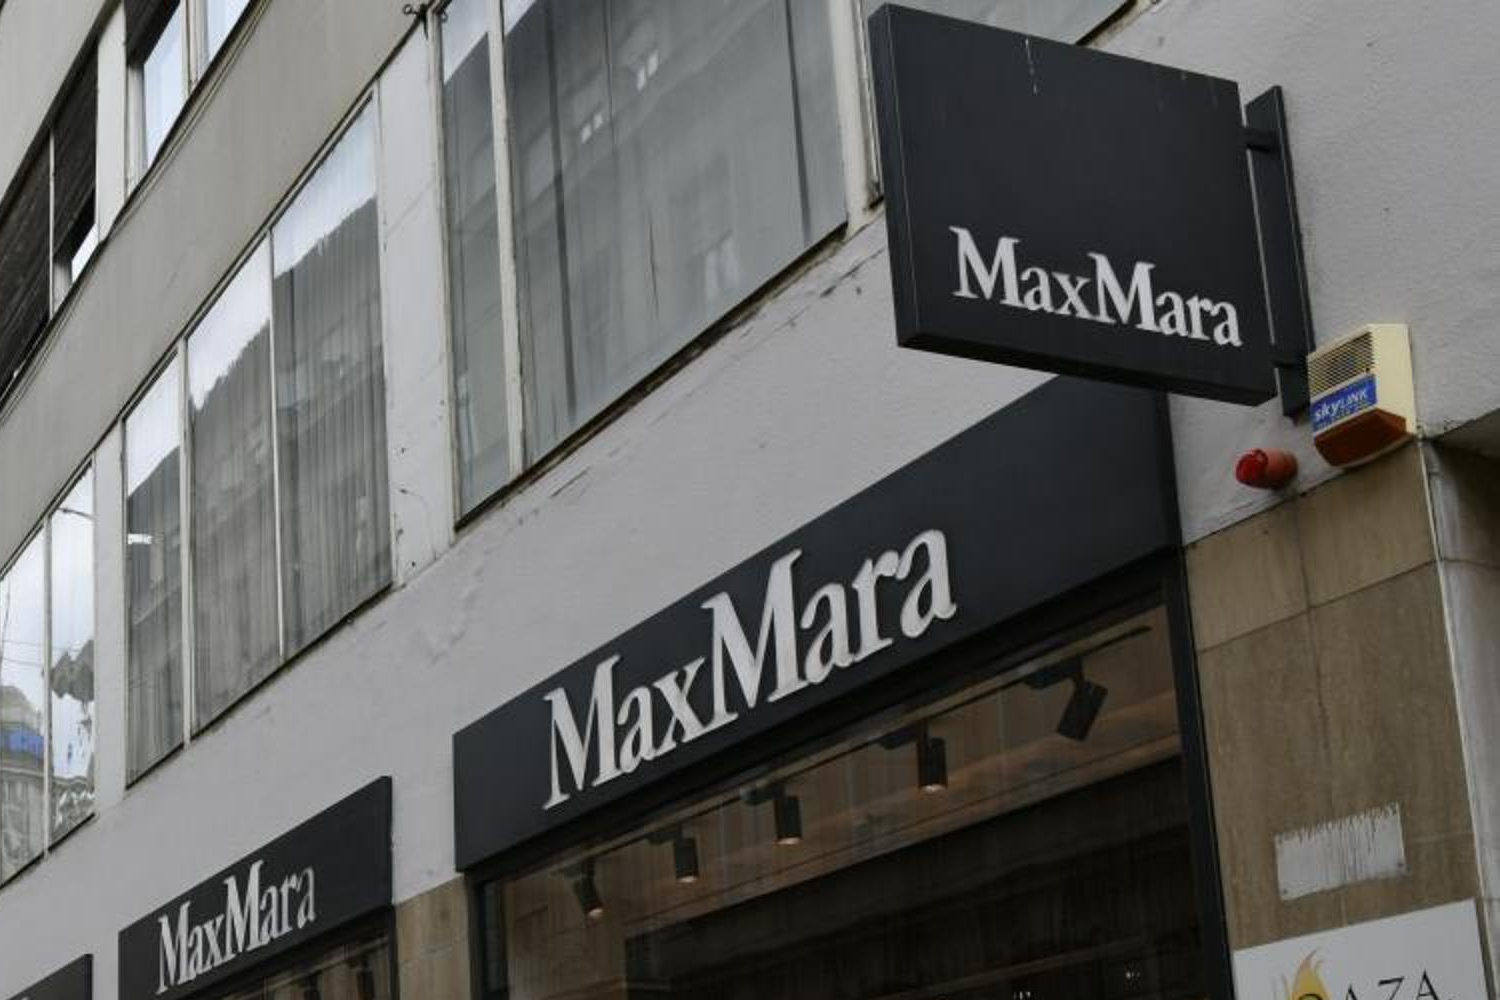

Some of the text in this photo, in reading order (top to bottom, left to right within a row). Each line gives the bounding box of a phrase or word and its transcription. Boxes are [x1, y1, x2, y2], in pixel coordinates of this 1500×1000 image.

[949, 225, 1243, 347] MaxMara
[542, 528, 957, 810] MaxMara
[155, 859, 316, 995] MaxMara
